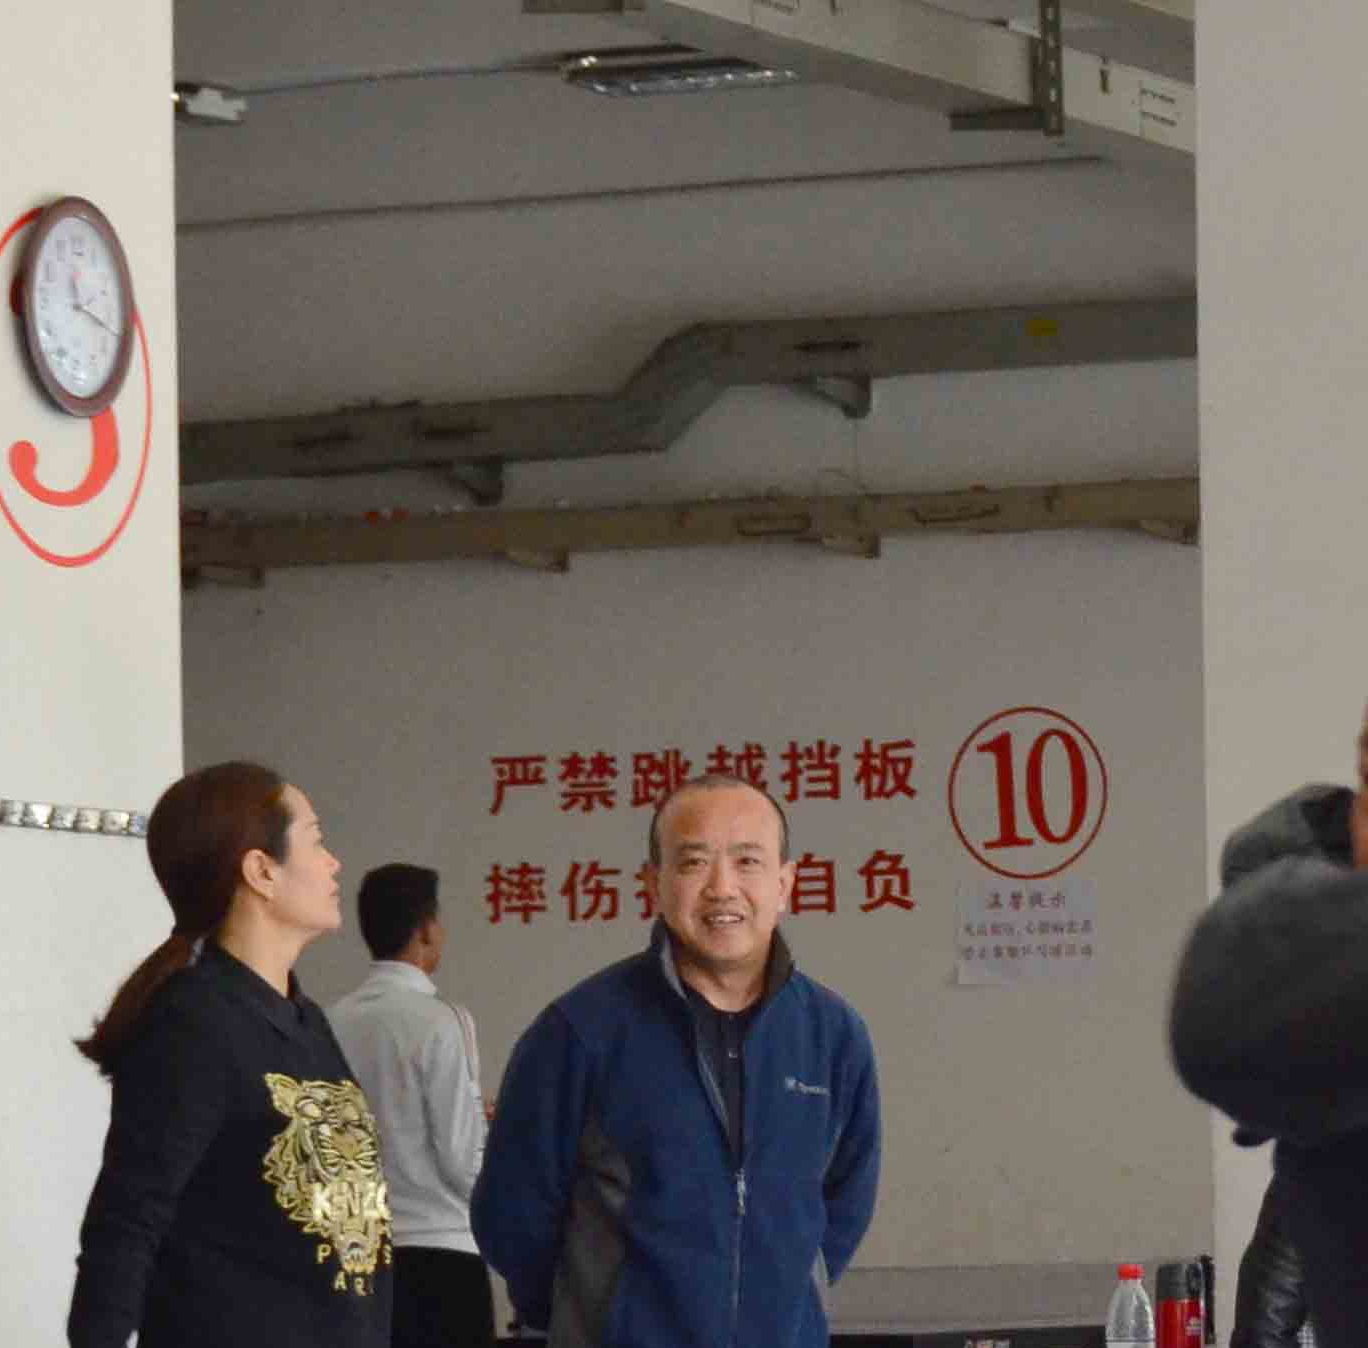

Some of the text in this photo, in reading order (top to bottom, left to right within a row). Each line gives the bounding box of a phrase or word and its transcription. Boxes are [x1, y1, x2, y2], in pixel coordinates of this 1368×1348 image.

[489, 739, 917, 815] 严禁跳越挡板
[976, 728, 1089, 850] 10
[486, 850, 916, 923] 摔伤自负
